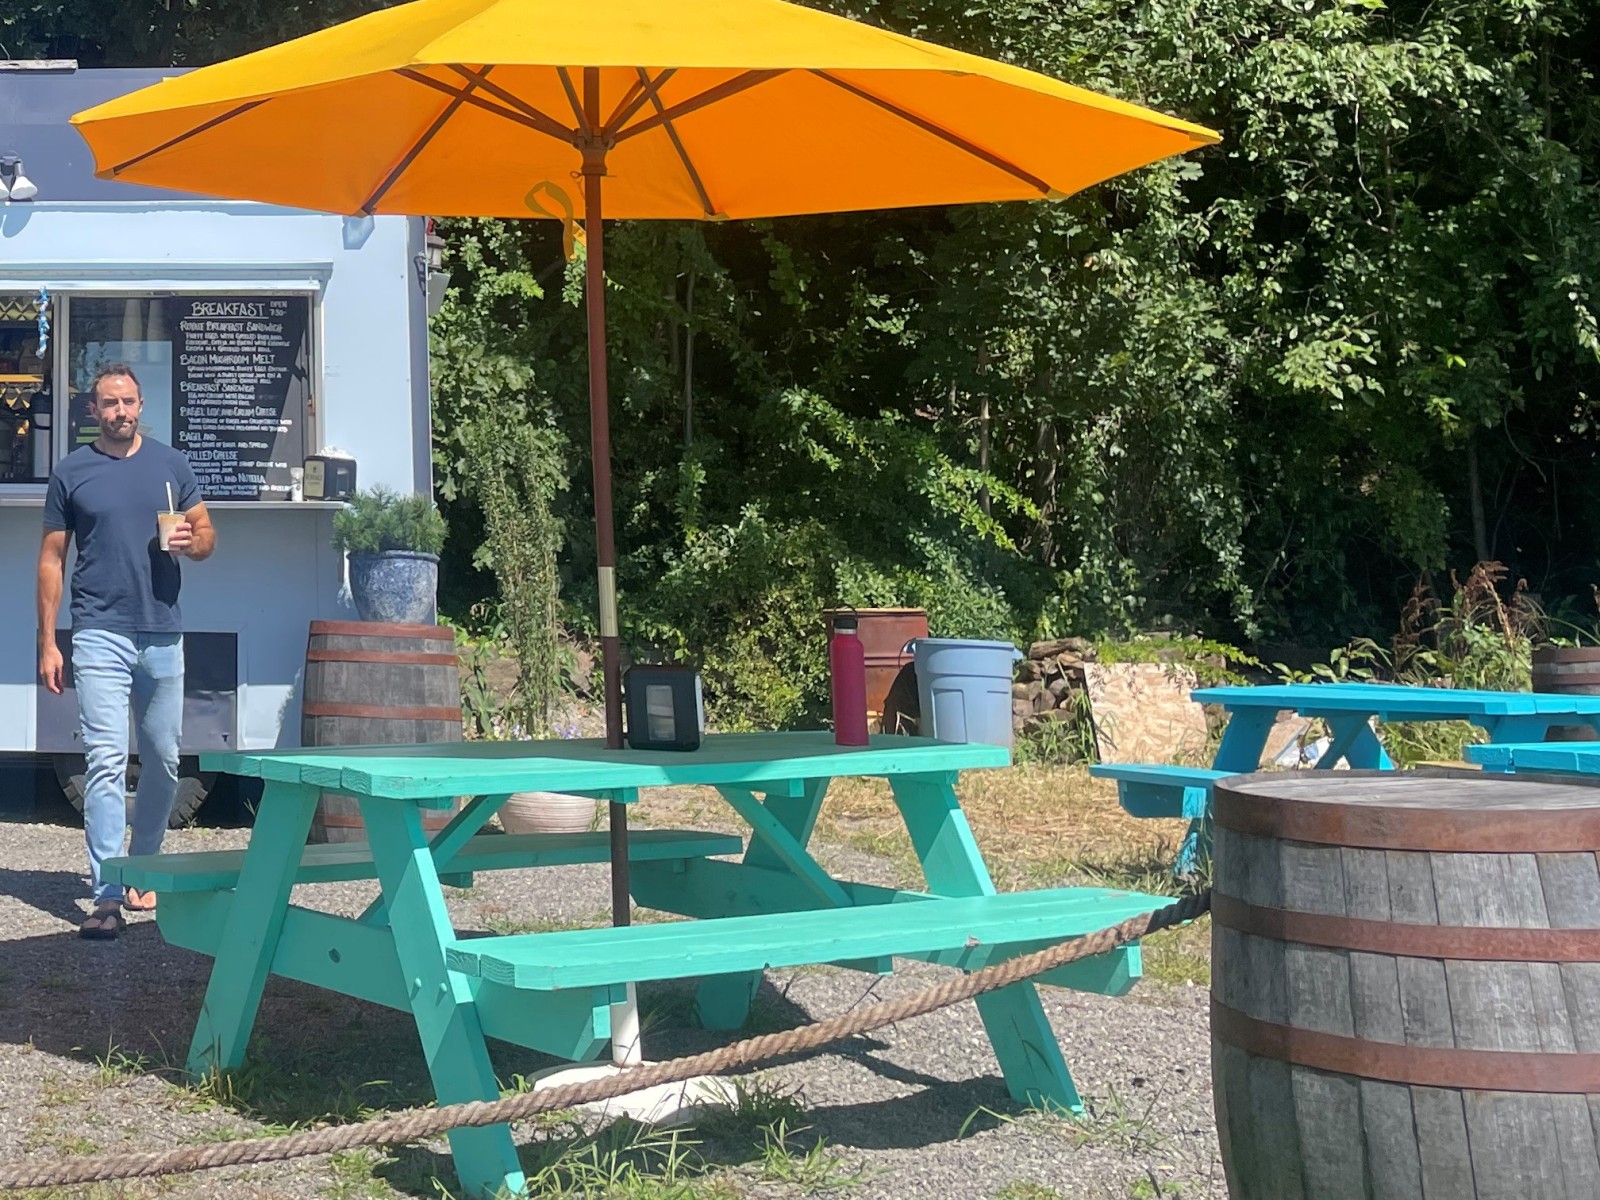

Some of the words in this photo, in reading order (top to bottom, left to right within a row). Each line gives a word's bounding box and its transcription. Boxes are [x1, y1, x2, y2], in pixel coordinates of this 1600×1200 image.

[192, 302, 265, 316] BREAKFAST
[206, 321, 244, 331] BREAKFAST
[247, 322, 283, 332] SANDWICH
[180, 355, 207, 365] BACON
[209, 354, 249, 364] MUSHROOM
[253, 354, 275, 364] MELT
[180, 381, 220, 392] BREAKFAST
[222, 384, 255, 392] SANDWICH
[180, 407, 204, 416] BAGEL
[255, 406, 277, 416] CHEESE
[179, 431, 201, 441] BAGEL
[213, 449, 238, 460] CHEESE
[238, 473, 266, 483] NUTELLA
